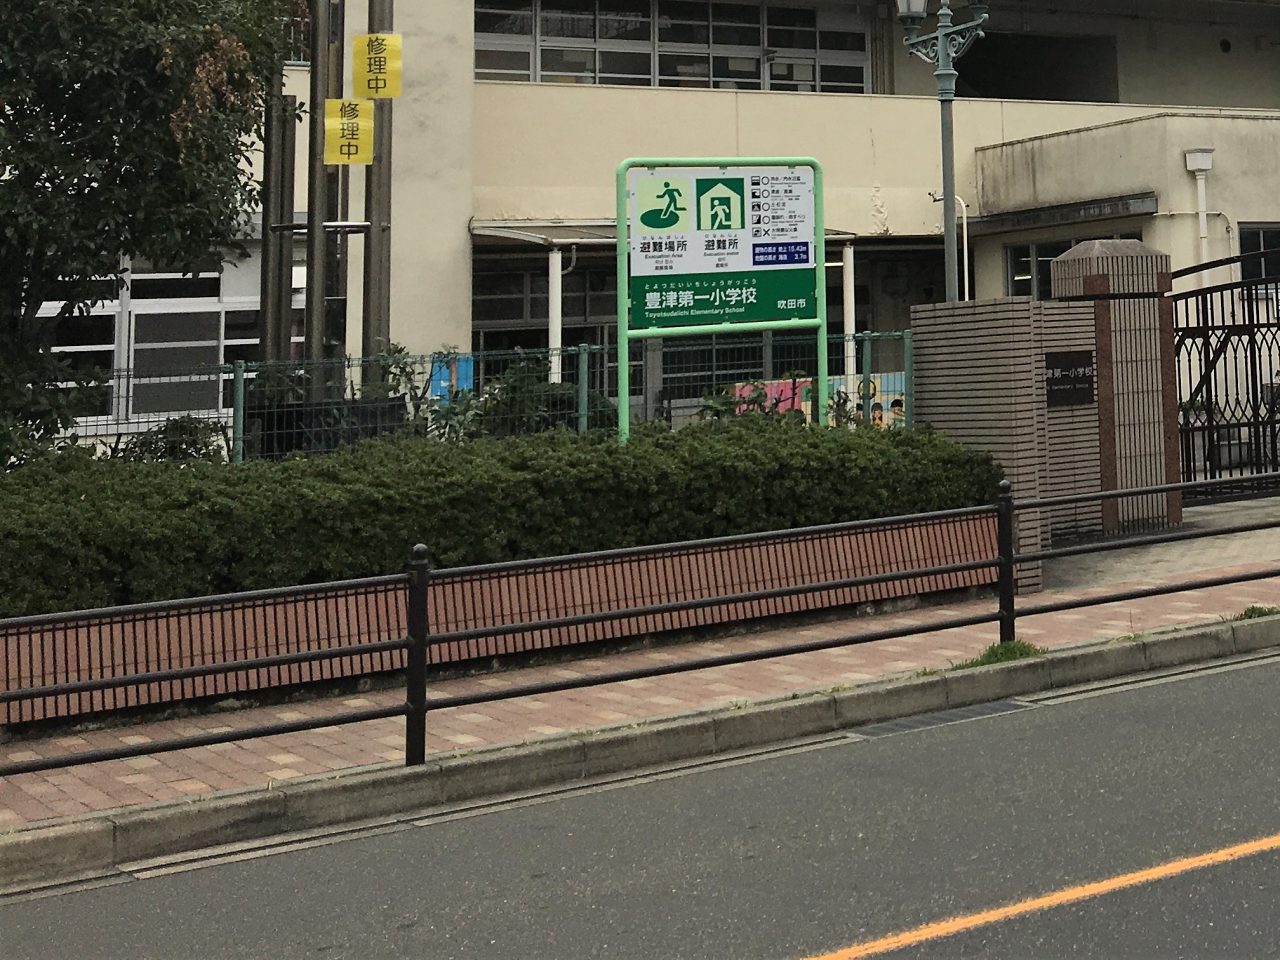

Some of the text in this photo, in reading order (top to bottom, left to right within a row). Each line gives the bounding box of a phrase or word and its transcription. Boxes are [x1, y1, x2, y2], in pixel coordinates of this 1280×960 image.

[366, 36, 387, 94] 修理中
[340, 101, 359, 160] 修理中
[639, 240, 687, 253] 避難場所
[704, 238, 739, 251] 避難所
[644, 287, 757, 310] 豊津第一小学校
[777, 298, 806, 310] 吹田市
[690, 308, 724, 316] Elementary
[725, 306, 745, 314] School
